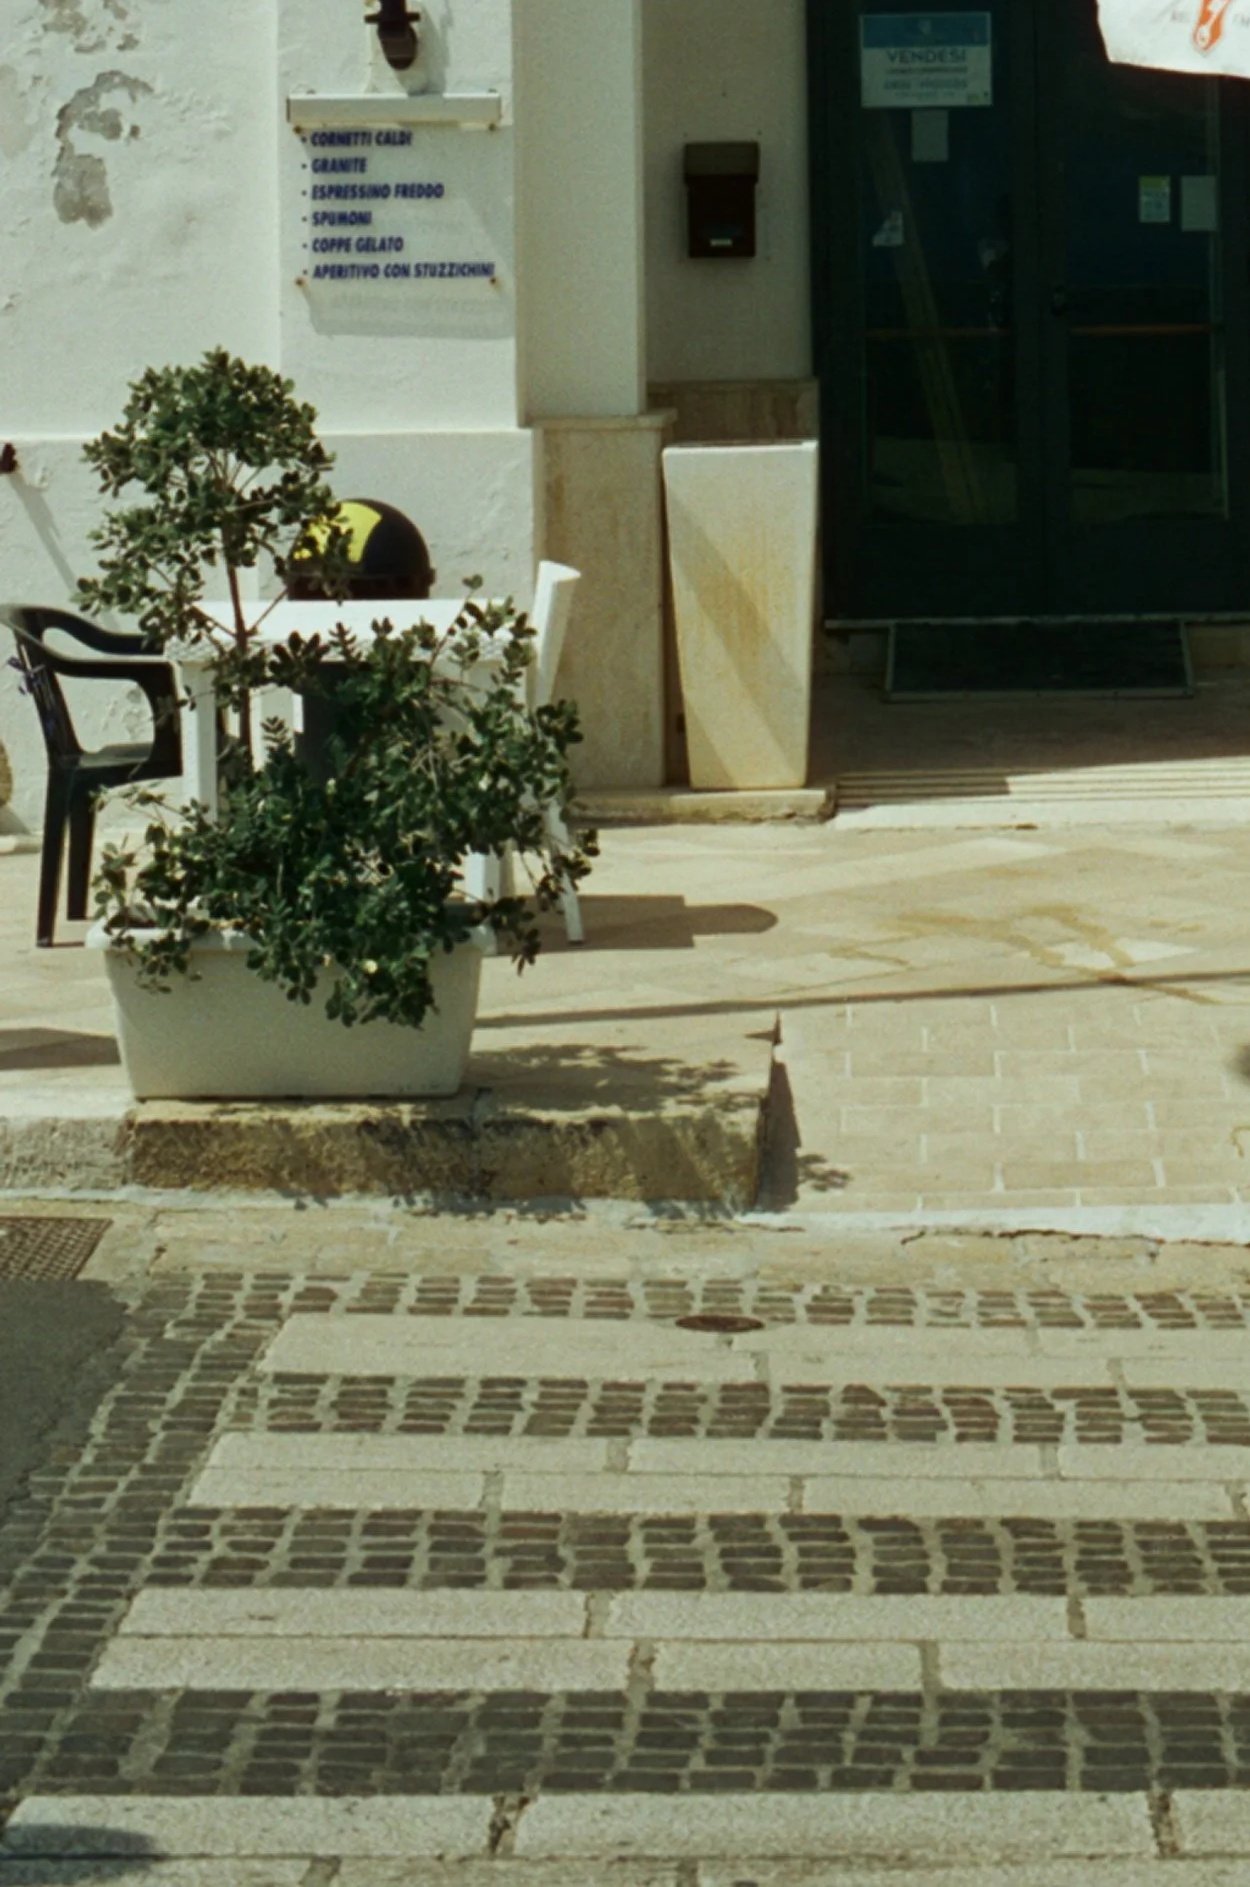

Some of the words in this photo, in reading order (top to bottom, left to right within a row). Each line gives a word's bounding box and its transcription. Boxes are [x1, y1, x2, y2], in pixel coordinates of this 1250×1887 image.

[375, 131, 412, 146] CALDI
[311, 158, 367, 174] GRANITE
[311, 185, 390, 201] ESPRESSINO
[394, 183, 444, 198] FREDDO
[311, 211, 372, 226] SPUMONI
[311, 238, 351, 253] COPPE
[355, 237, 404, 252] GELATO
[312, 265, 379, 280] APERITIVO
[383, 264, 410, 279] CON
[414, 263, 495, 278] STUZZICHINI
